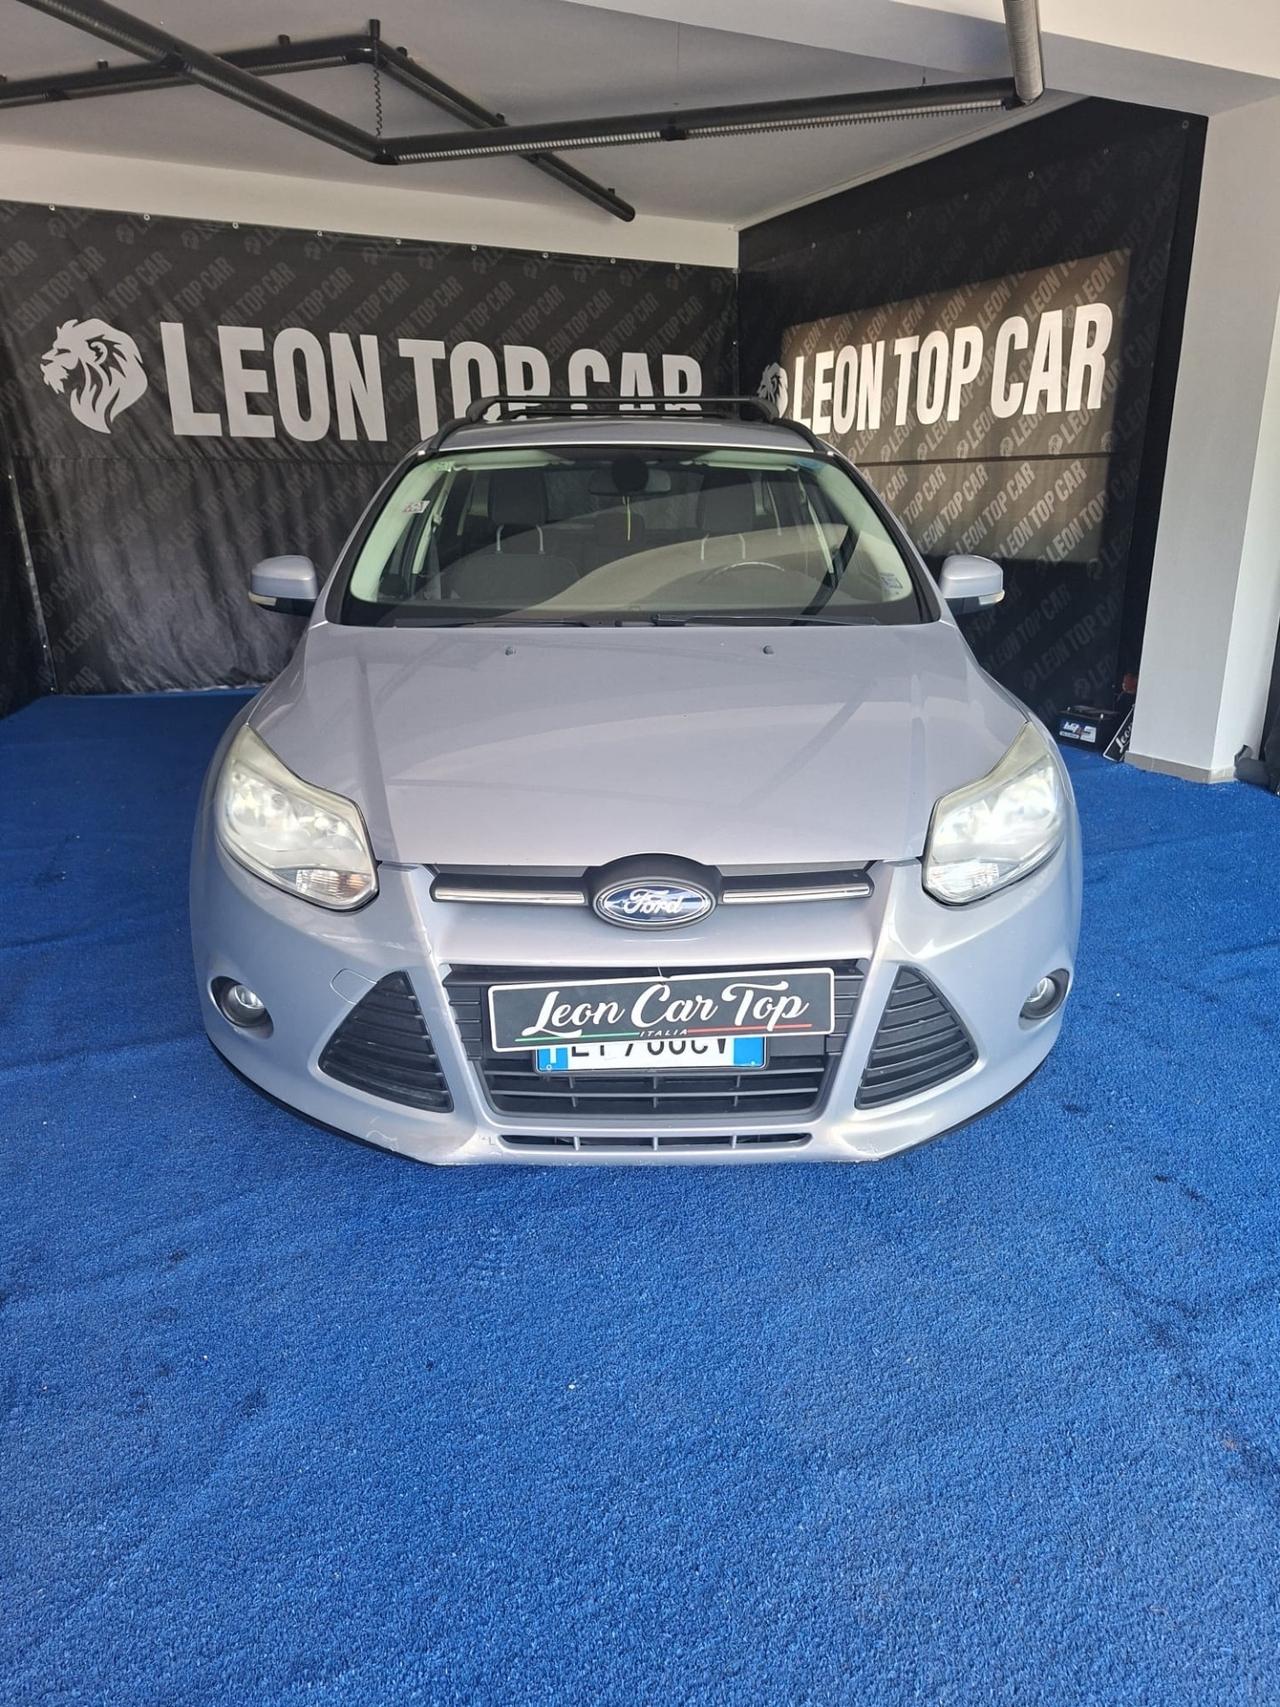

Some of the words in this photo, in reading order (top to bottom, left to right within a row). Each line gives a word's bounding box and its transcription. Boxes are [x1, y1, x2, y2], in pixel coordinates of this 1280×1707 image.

[40, 270, 76, 307] TOP
[67, 245, 107, 282] CAR
[107, 274, 142, 310] TOP
[135, 251, 173, 287] CAR
[173, 279, 206, 313] TOP
[201, 256, 236, 291] CAR
[235, 285, 268, 317] TOP
[261, 261, 297, 296] CAR
[296, 289, 327, 322] TOP
[321, 266, 354, 300] CAR
[354, 294, 384, 326] TOP
[378, 271, 411, 305] CAR
[410, 297, 438, 330] TOP
[433, 275, 464, 309] CAR
[1024, 270, 1062, 323] LEON
[464, 302, 491, 332] TOP
[485, 279, 517, 313] CAR
[515, 305, 542, 335] TOP
[537, 284, 567, 317] CAR
[545, 329, 574, 364] EON
[565, 309, 591, 340] TOP
[586, 288, 614, 321] CAR
[612, 312, 637, 343] TOP
[633, 291, 660, 324] CAR
[658, 315, 681, 345] TOP
[676, 295, 703, 326] CAR
[160, 320, 388, 442] LEON
[398, 337, 551, 441] TOP
[567, 347, 703, 419] CAR
[792, 339, 885, 435] LEON
[894, 325, 984, 426] TOP
[990, 303, 1113, 419] CAR
[855, 429, 877, 455] LEO
[925, 411, 952, 451] LEO
[1060, 402, 1092, 445] LEO
[885, 466, 909, 501] CAR
[903, 490, 924, 524] TOP
[922, 464, 947, 502] CAR
[940, 490, 963, 526] TOP
[962, 463, 989, 502] CAR
[955, 516, 988, 554] LEON
[982, 490, 1008, 527] TOP
[1006, 462, 1036, 502] CAR
[999, 516, 1034, 558] LEON
[1028, 490, 1055, 529] TOP
[1054, 459, 1087, 502] CAR
[1046, 517, 1085, 566] LEON
[1064, 613, 1097, 650] TOP
[623, 888, 684, 915] Ford
[522, 990, 625, 1038] Leon
[630, 983, 719, 1028] Car
[721, 980, 810, 1032] Top
[639, 1028, 689, 1038] ITALIA
